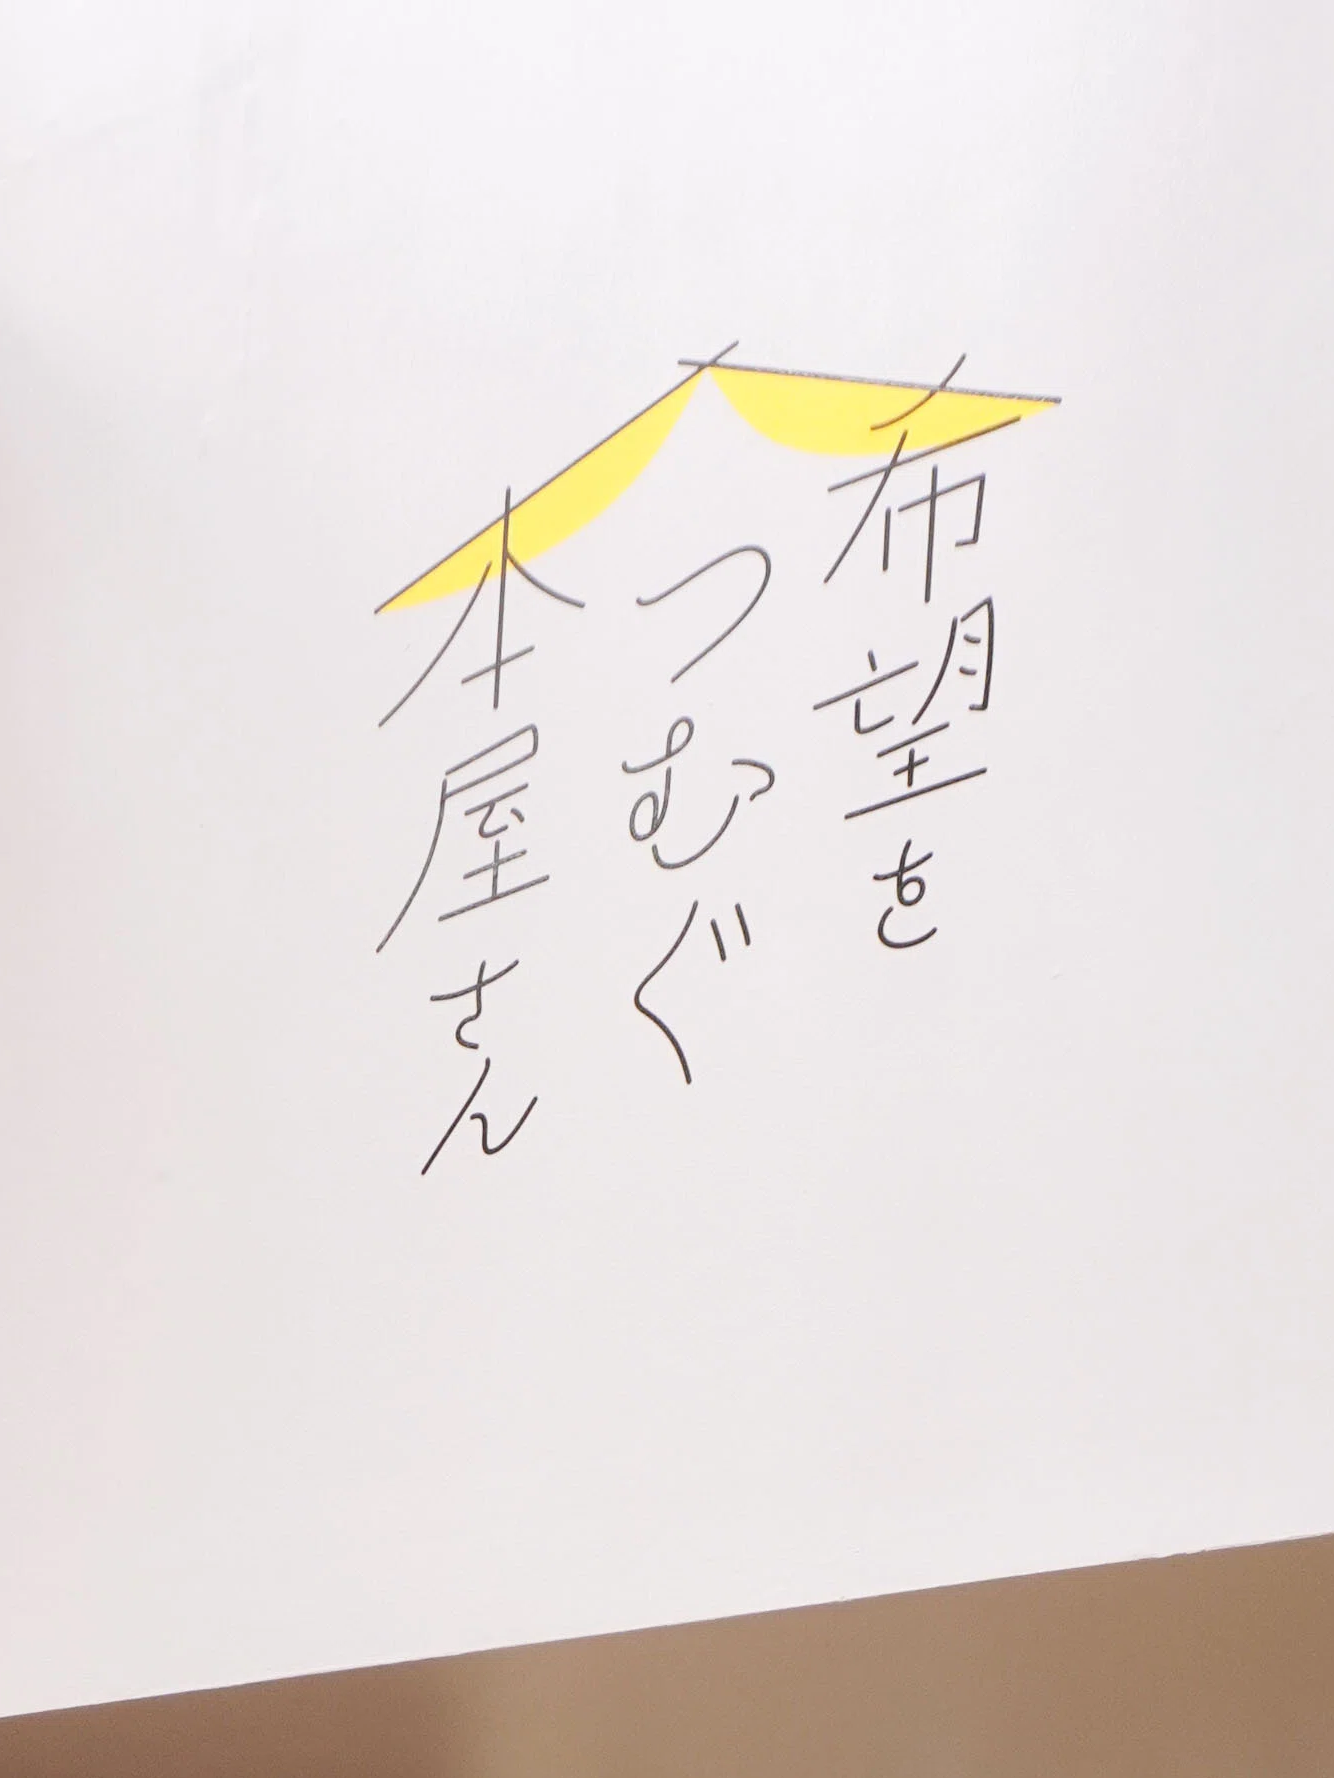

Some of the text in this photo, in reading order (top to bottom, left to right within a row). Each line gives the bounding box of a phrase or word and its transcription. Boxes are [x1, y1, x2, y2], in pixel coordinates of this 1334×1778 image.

[376, 486, 585, 1175] 本屋さん
[622, 545, 775, 1084] つむぐ
